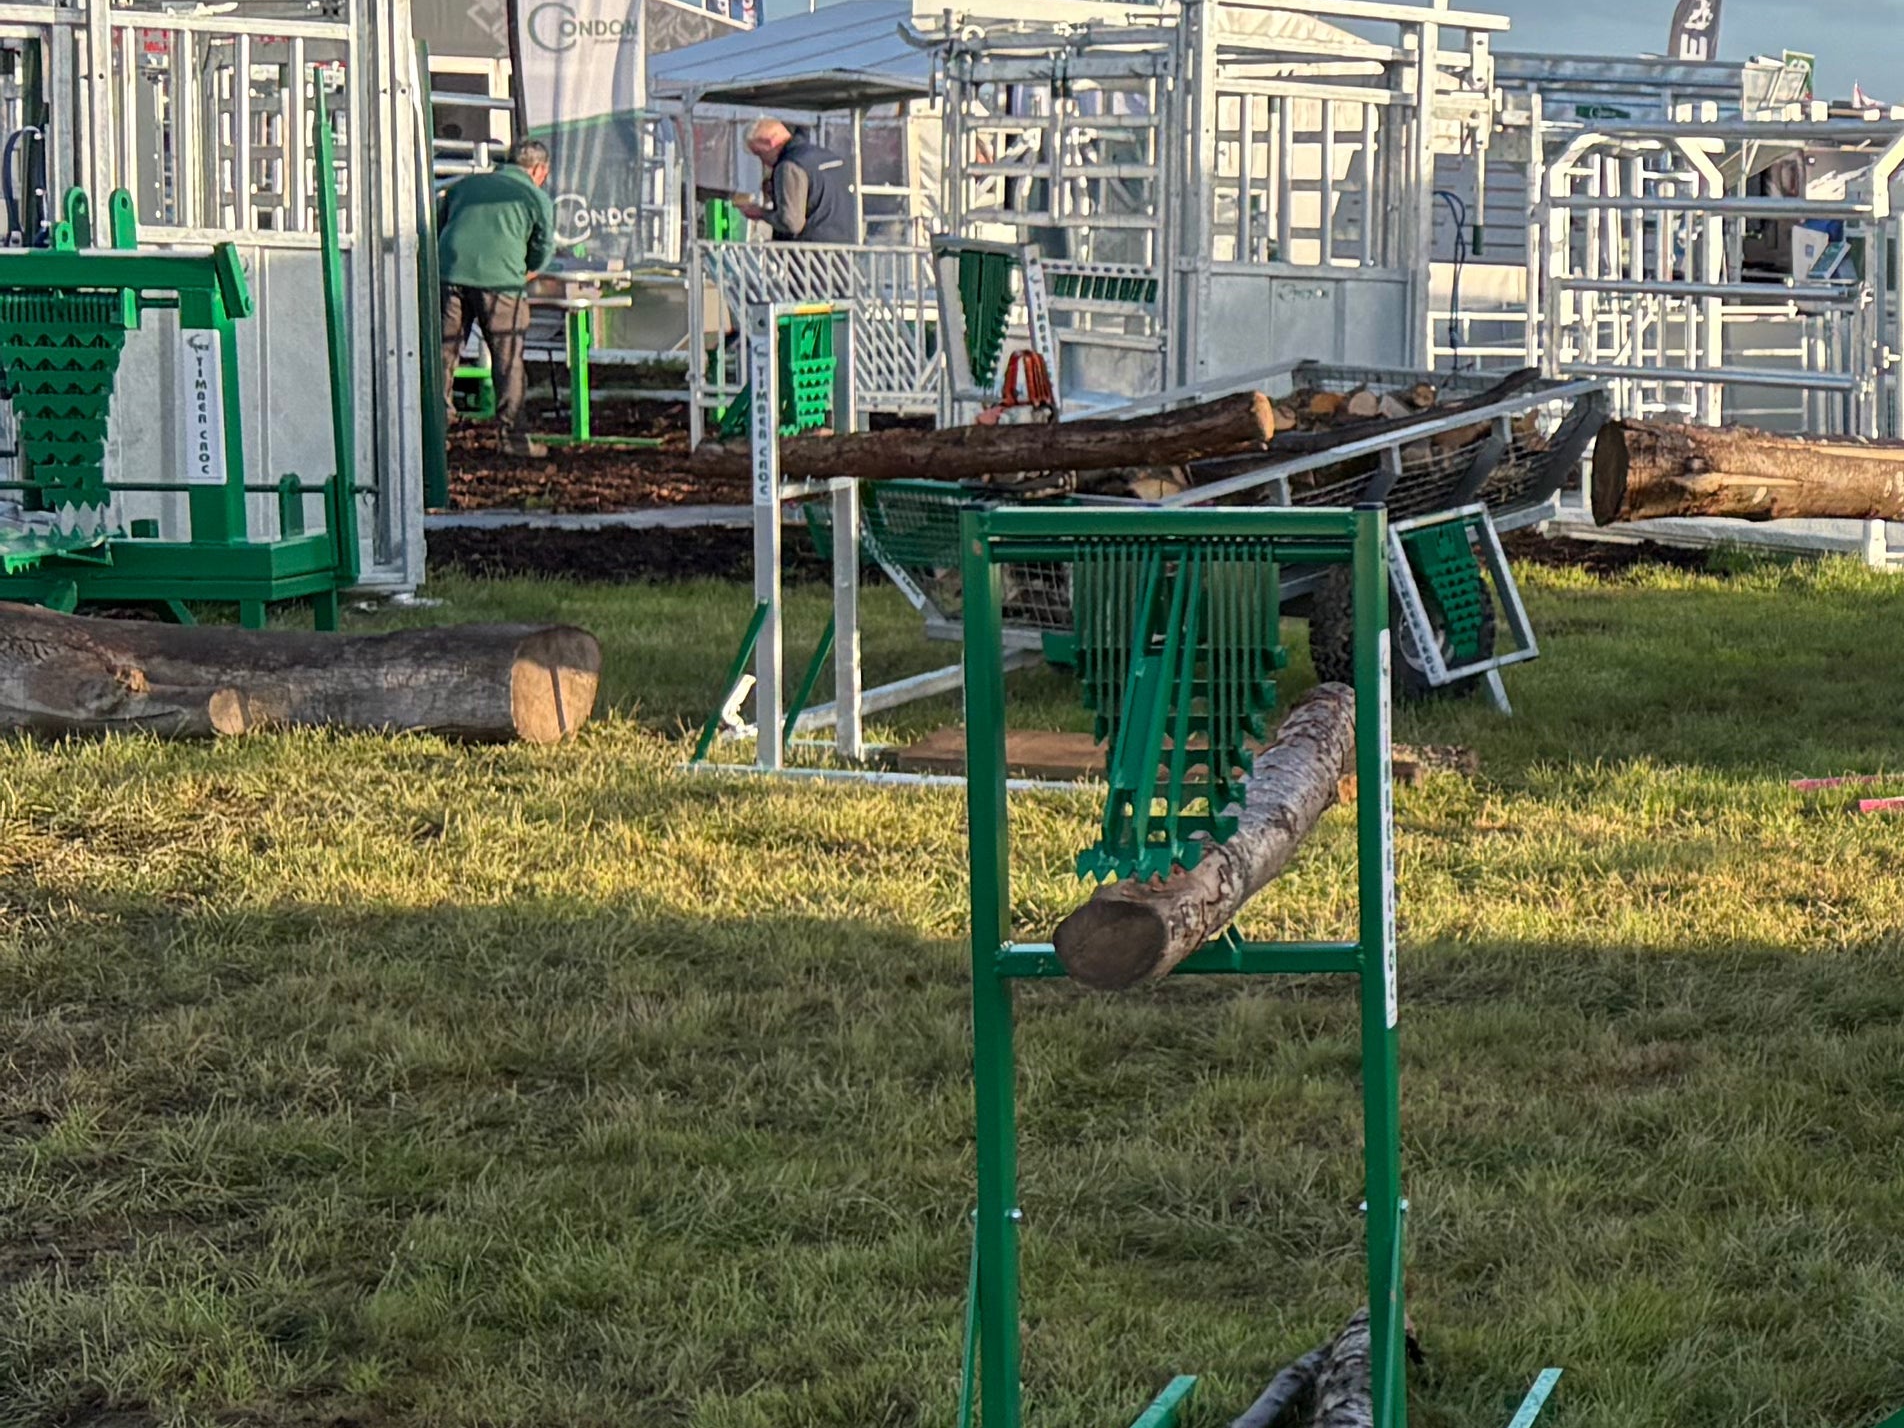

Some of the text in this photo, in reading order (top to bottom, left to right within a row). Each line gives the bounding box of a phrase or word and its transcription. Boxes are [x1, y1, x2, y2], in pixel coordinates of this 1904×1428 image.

[527, 2, 638, 53] CONDON
[553, 192, 637, 248] CONDO
[196, 356, 211, 475] TIMBER CROC
[755, 366, 770, 496] TIMBER CROC
